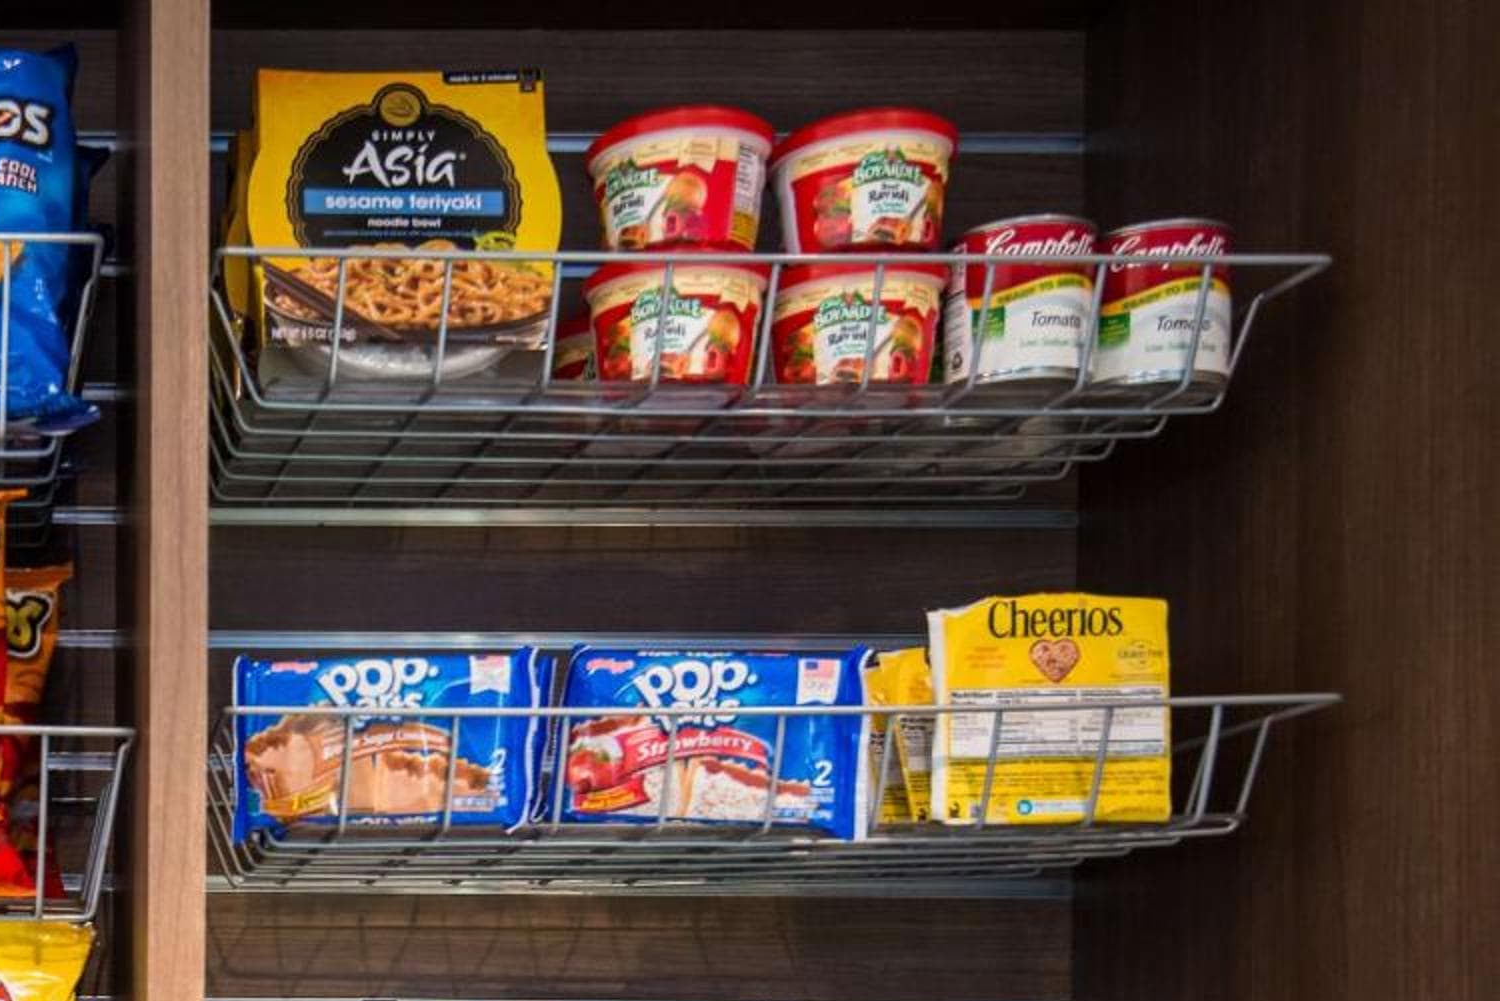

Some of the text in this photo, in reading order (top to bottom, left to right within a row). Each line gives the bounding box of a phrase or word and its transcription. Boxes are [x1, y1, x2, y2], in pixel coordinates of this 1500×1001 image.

[371, 130, 436, 141] SIMPLY
[342, 139, 457, 188] Asia
[325, 193, 483, 213] sesame teriyaki
[367, 217, 442, 228] noodle bowl
[1157, 315, 1211, 332] Tomao
[988, 600, 1123, 639] Cheerios
[637, 734, 752, 760] Strwberry
[814, 761, 833, 787] 2
